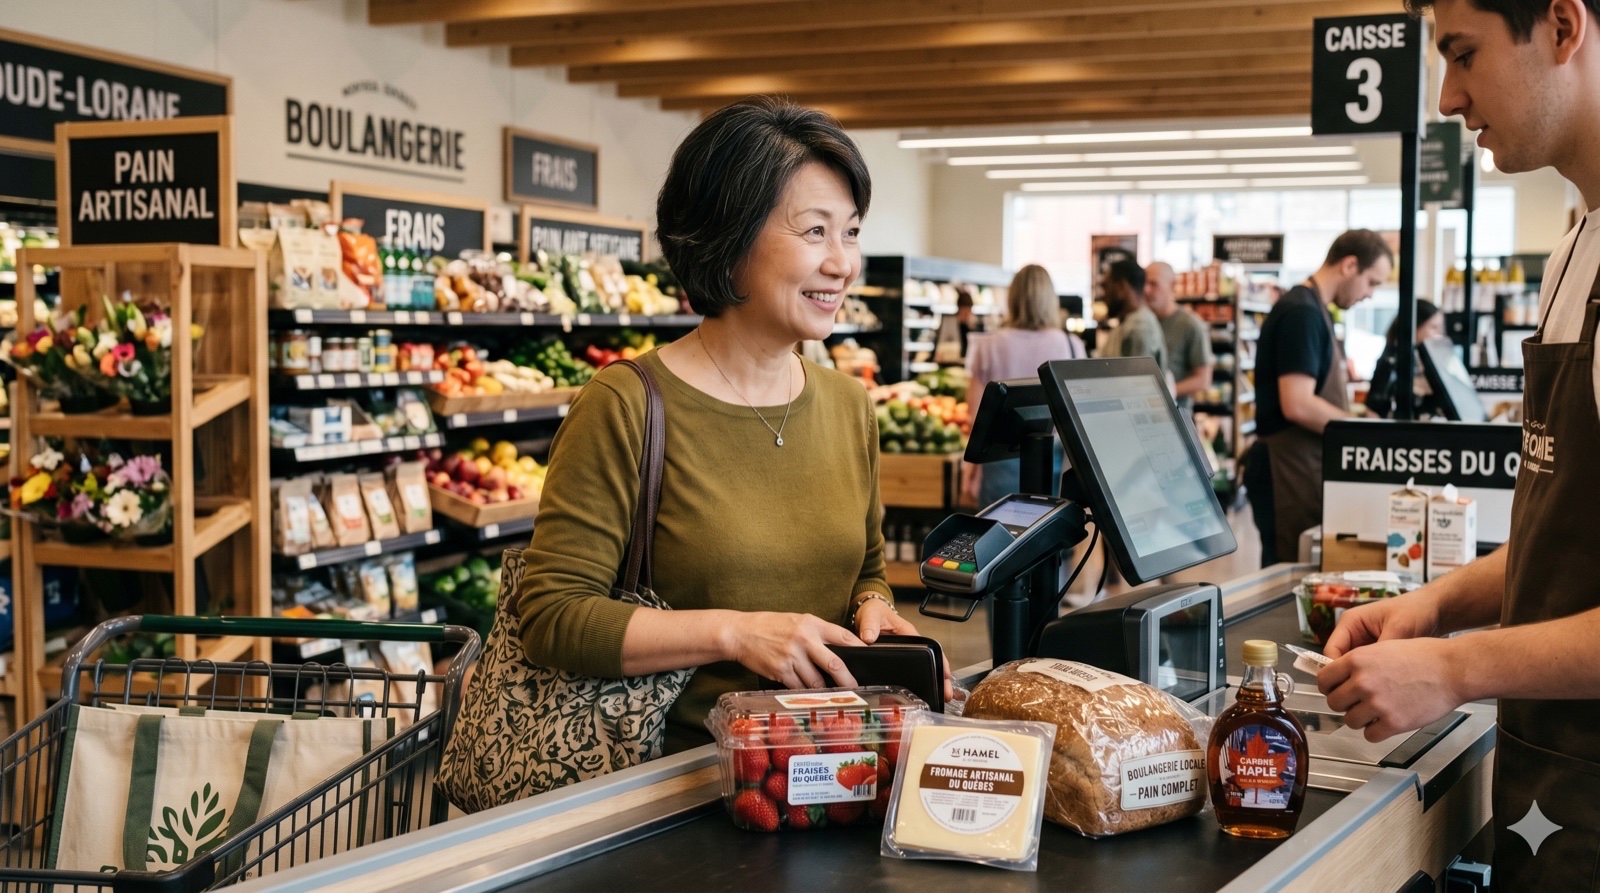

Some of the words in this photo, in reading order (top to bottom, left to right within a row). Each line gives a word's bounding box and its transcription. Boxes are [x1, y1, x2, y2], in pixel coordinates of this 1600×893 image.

[1325, 23, 1406, 52] CAISSE
[0, 62, 180, 119] UDE-LORANE
[1345, 57, 1383, 124] 3
[286, 98, 465, 170] BOULANGERIE
[115, 149, 175, 185] PAIN
[532, 151, 578, 192] FRAIS
[78, 187, 214, 222] ARTISANAL
[385, 208, 446, 252] FRAIS
[1341, 446, 1453, 474] FRAISSES
[1460, 450, 1496, 476] DU
[963, 748, 1000, 759] HAMEL
[793, 766, 829, 775] FRAISES
[930, 766, 968, 779] FROMAGE
[969, 770, 1015, 783] ARTISANAL
[949, 778, 961, 788] DU
[1127, 760, 1179, 781] BOULANGERIE
[1180, 758, 1206, 771] LOCALE
[1236, 765, 1278, 777] HAPLE
[1138, 784, 1159, 800] PAIN
[1161, 778, 1199, 797] COMPLET
